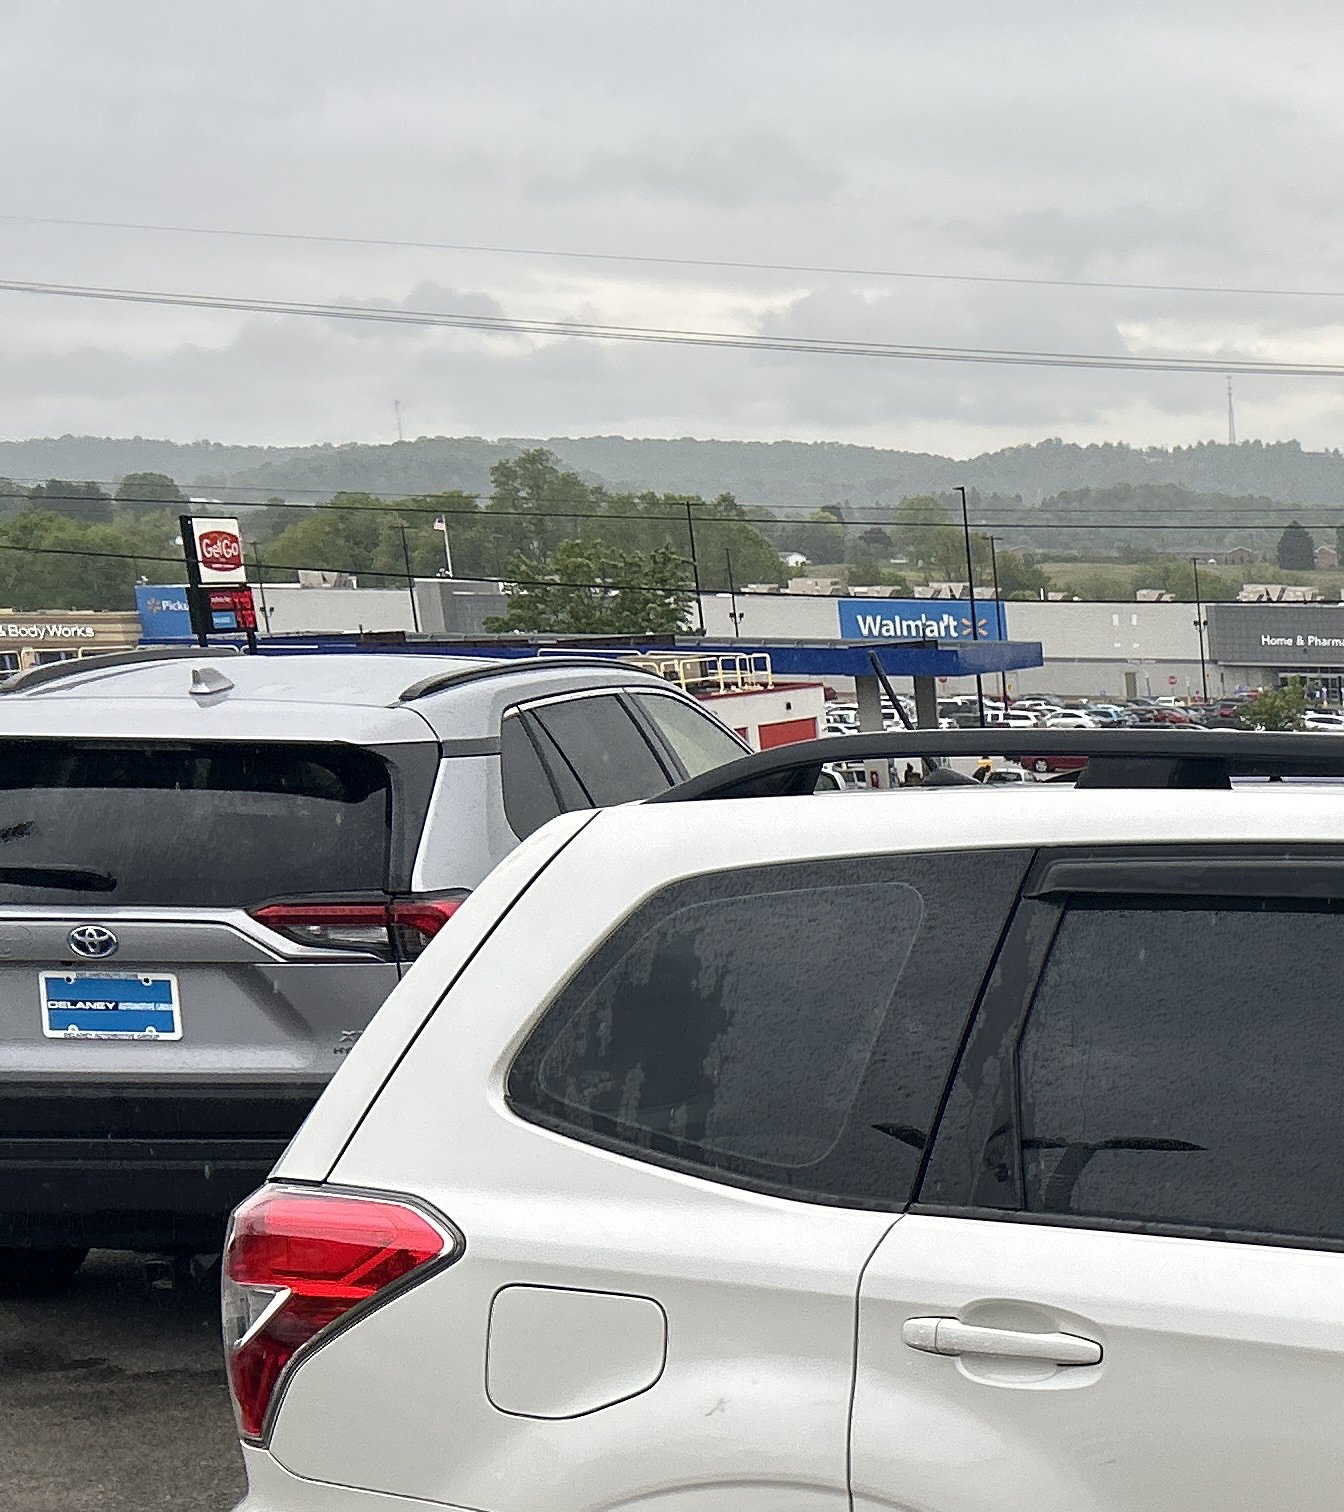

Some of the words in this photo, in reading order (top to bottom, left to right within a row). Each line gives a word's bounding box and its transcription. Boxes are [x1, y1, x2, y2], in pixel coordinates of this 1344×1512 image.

[202, 538, 239, 558] GetGo
[161, 600, 189, 611] Picku
[7, 624, 46, 640] Body
[46, 624, 95, 638] Works
[856, 614, 959, 638] Walmart
[1261, 634, 1293, 646] Home
[1296, 634, 1305, 646] &
[47, 1000, 116, 1011] DELANEY
